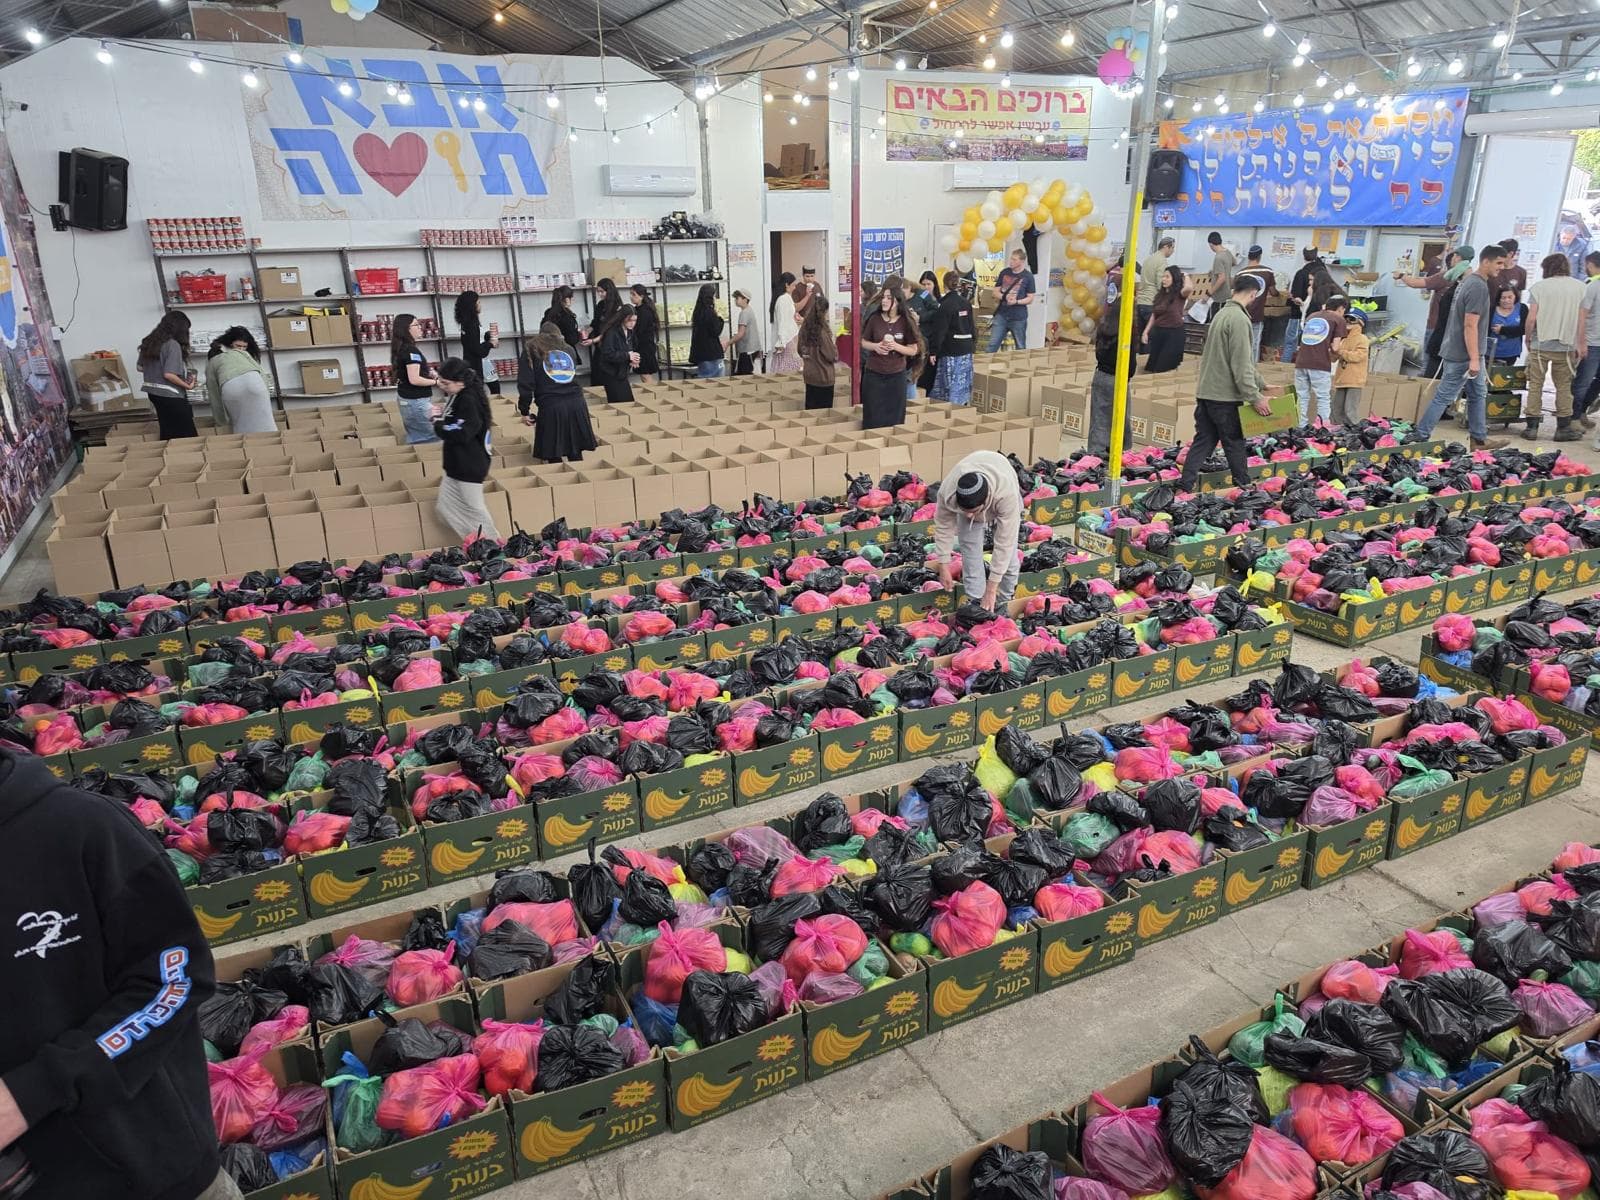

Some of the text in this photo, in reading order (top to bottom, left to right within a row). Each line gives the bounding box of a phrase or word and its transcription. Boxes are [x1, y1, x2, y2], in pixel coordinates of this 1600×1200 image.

[283, 57, 519, 131] אבא
[894, 86, 1087, 114] ברוכים הבאים
[932, 118, 977, 130] להתחיל
[980, 119, 1014, 130] אפשר
[1329, 140, 1401, 182] הוא
[1411, 139, 1454, 170] כי
[1306, 617, 1327, 631] בננות
[1269, 648, 1289, 661] בננות
[1210, 663, 1229, 675] בננות
[1149, 679, 1170, 692] בננות
[1085, 694, 1107, 706] בננות
[1018, 714, 1041, 727] בננות
[945, 733, 970, 746] בננות
[869, 747, 894, 762] בננות
[788, 770, 815, 785] בננות
[1562, 770, 1582, 785] בננות
[699, 792, 728, 809] בננות
[1501, 793, 1522, 808] בננות
[603, 818, 635, 835] בננות
[1434, 819, 1457, 836] בננות
[496, 845, 531, 862] בננות
[1358, 845, 1383, 863] בננות
[381, 871, 420, 892] בננות
[1271, 874, 1298, 891] בננות
[256, 908, 298, 928] בננות
[1186, 904, 1216, 923] בננות
[1100, 941, 1132, 962] בננות
[995, 977, 1031, 999] בננות
[881, 1020, 920, 1044] בננות
[754, 1066, 798, 1092] בננות
[609, 1114, 657, 1140] בננות
[450, 1164, 505, 1192] בננות
